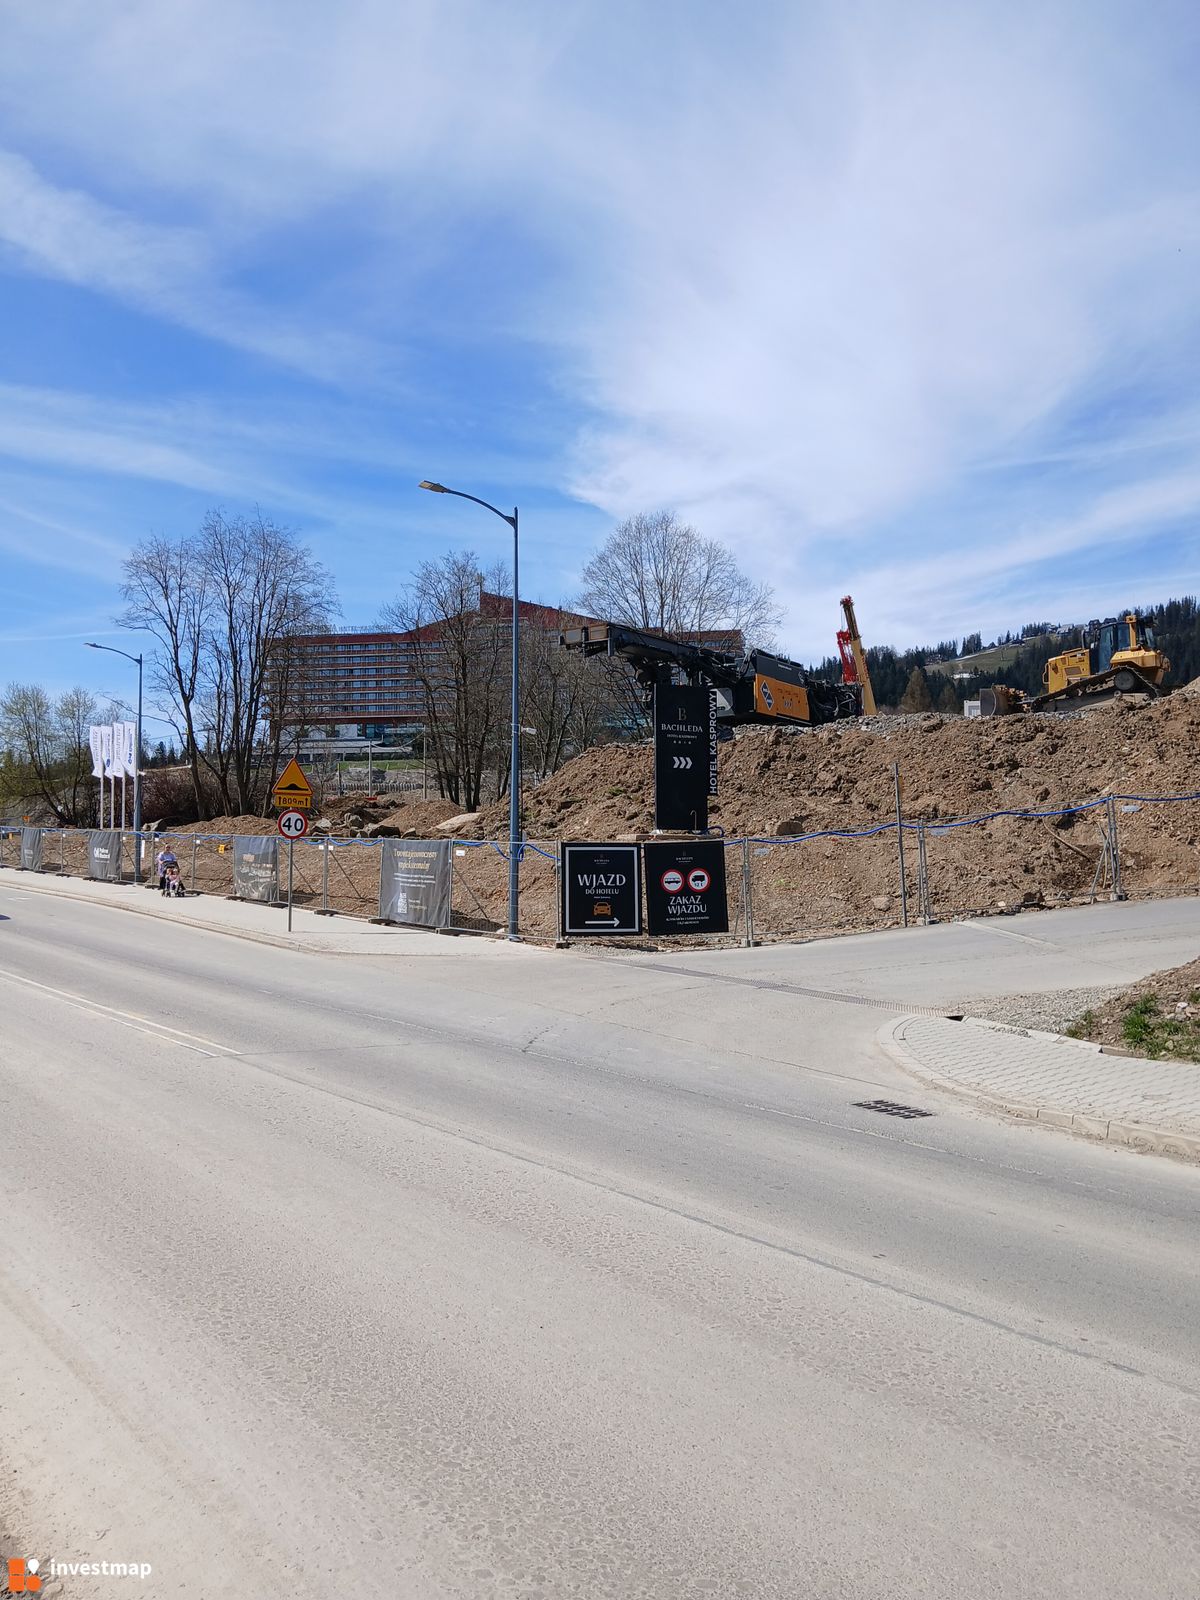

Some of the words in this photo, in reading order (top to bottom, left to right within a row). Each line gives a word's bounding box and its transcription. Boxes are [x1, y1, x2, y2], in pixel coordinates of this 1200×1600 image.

[661, 723, 704, 733] BACHLEDA
[709, 693, 717, 755] KASPROWY
[709, 758, 717, 794] HOTEL
[282, 816, 304, 832] 40
[577, 873, 626, 890] WJAZD
[669, 895, 702, 905] ZAKAZ
[667, 904, 707, 916] WJAZDU
